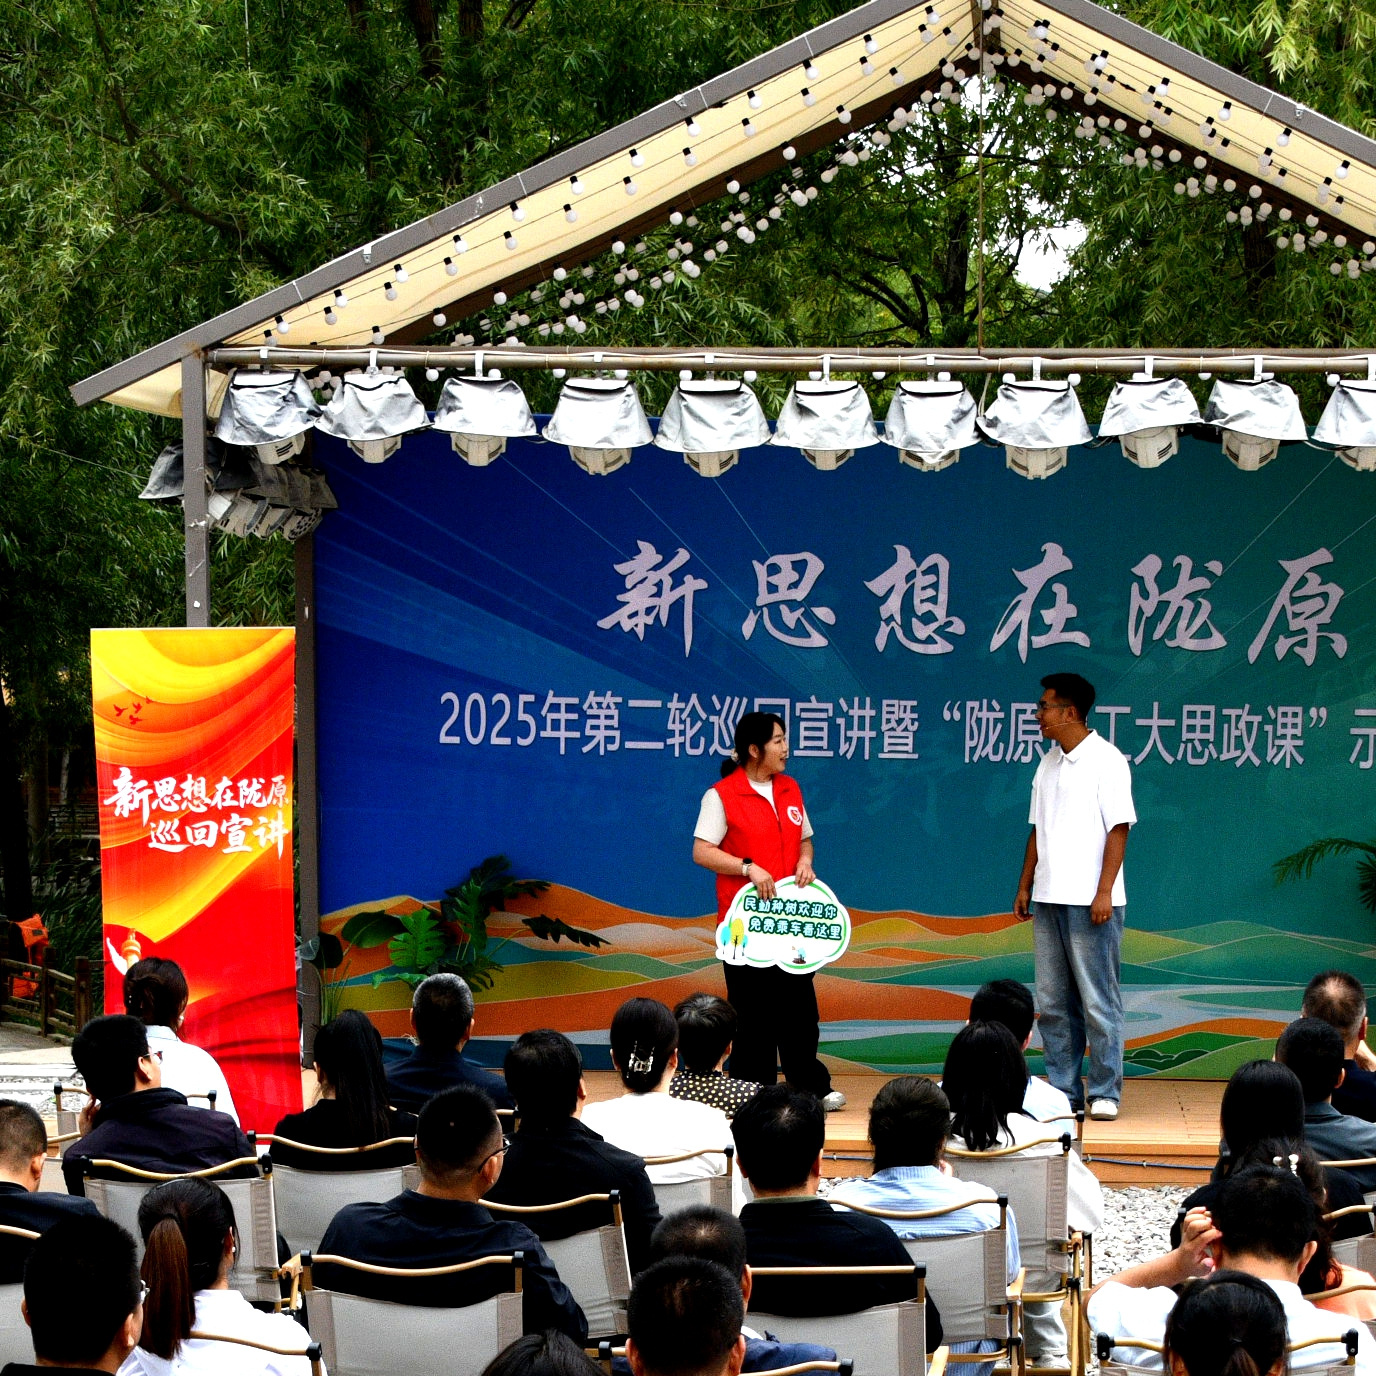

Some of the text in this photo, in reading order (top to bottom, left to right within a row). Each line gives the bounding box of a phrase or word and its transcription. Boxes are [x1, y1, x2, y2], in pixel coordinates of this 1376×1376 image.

[596, 539, 1348, 667] 新思想在陇原
[103, 766, 290, 827] 新思想在陇原
[147, 811, 291, 860] 巡回宣讲
[744, 895, 838, 919] 民勤种树欢迎你
[748, 917, 842, 941] 免费乘车看这里
